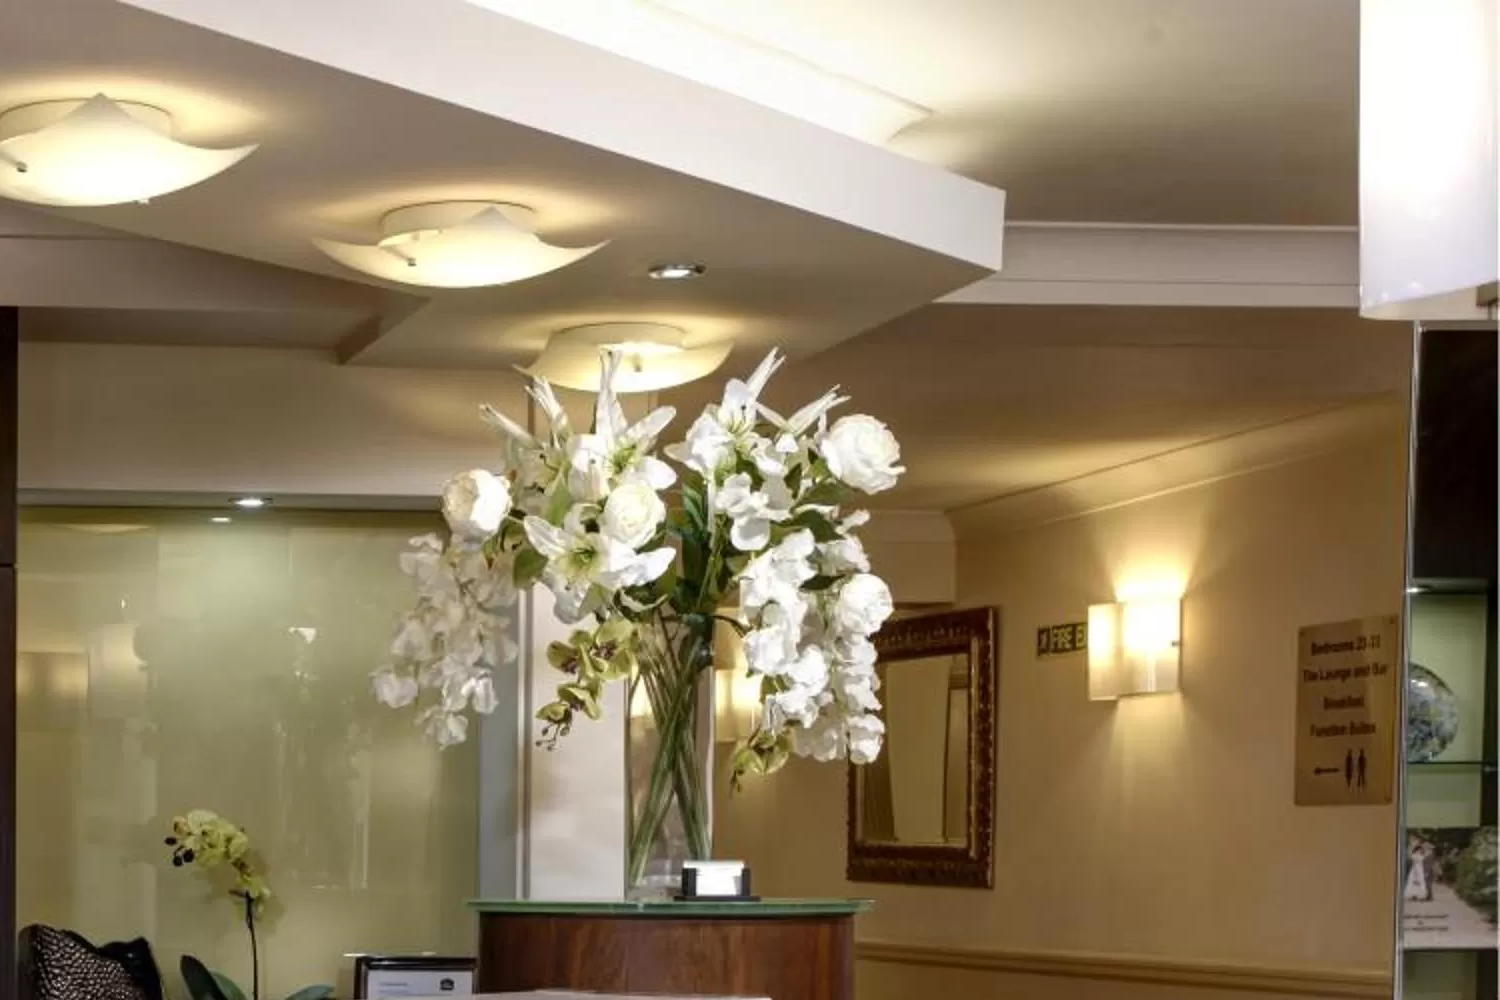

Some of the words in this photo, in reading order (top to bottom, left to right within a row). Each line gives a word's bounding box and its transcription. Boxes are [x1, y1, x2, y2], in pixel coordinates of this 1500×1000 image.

[1303, 670, 1318, 684] The
[1319, 668, 1350, 683] Lounge
[1353, 665, 1370, 678] and
